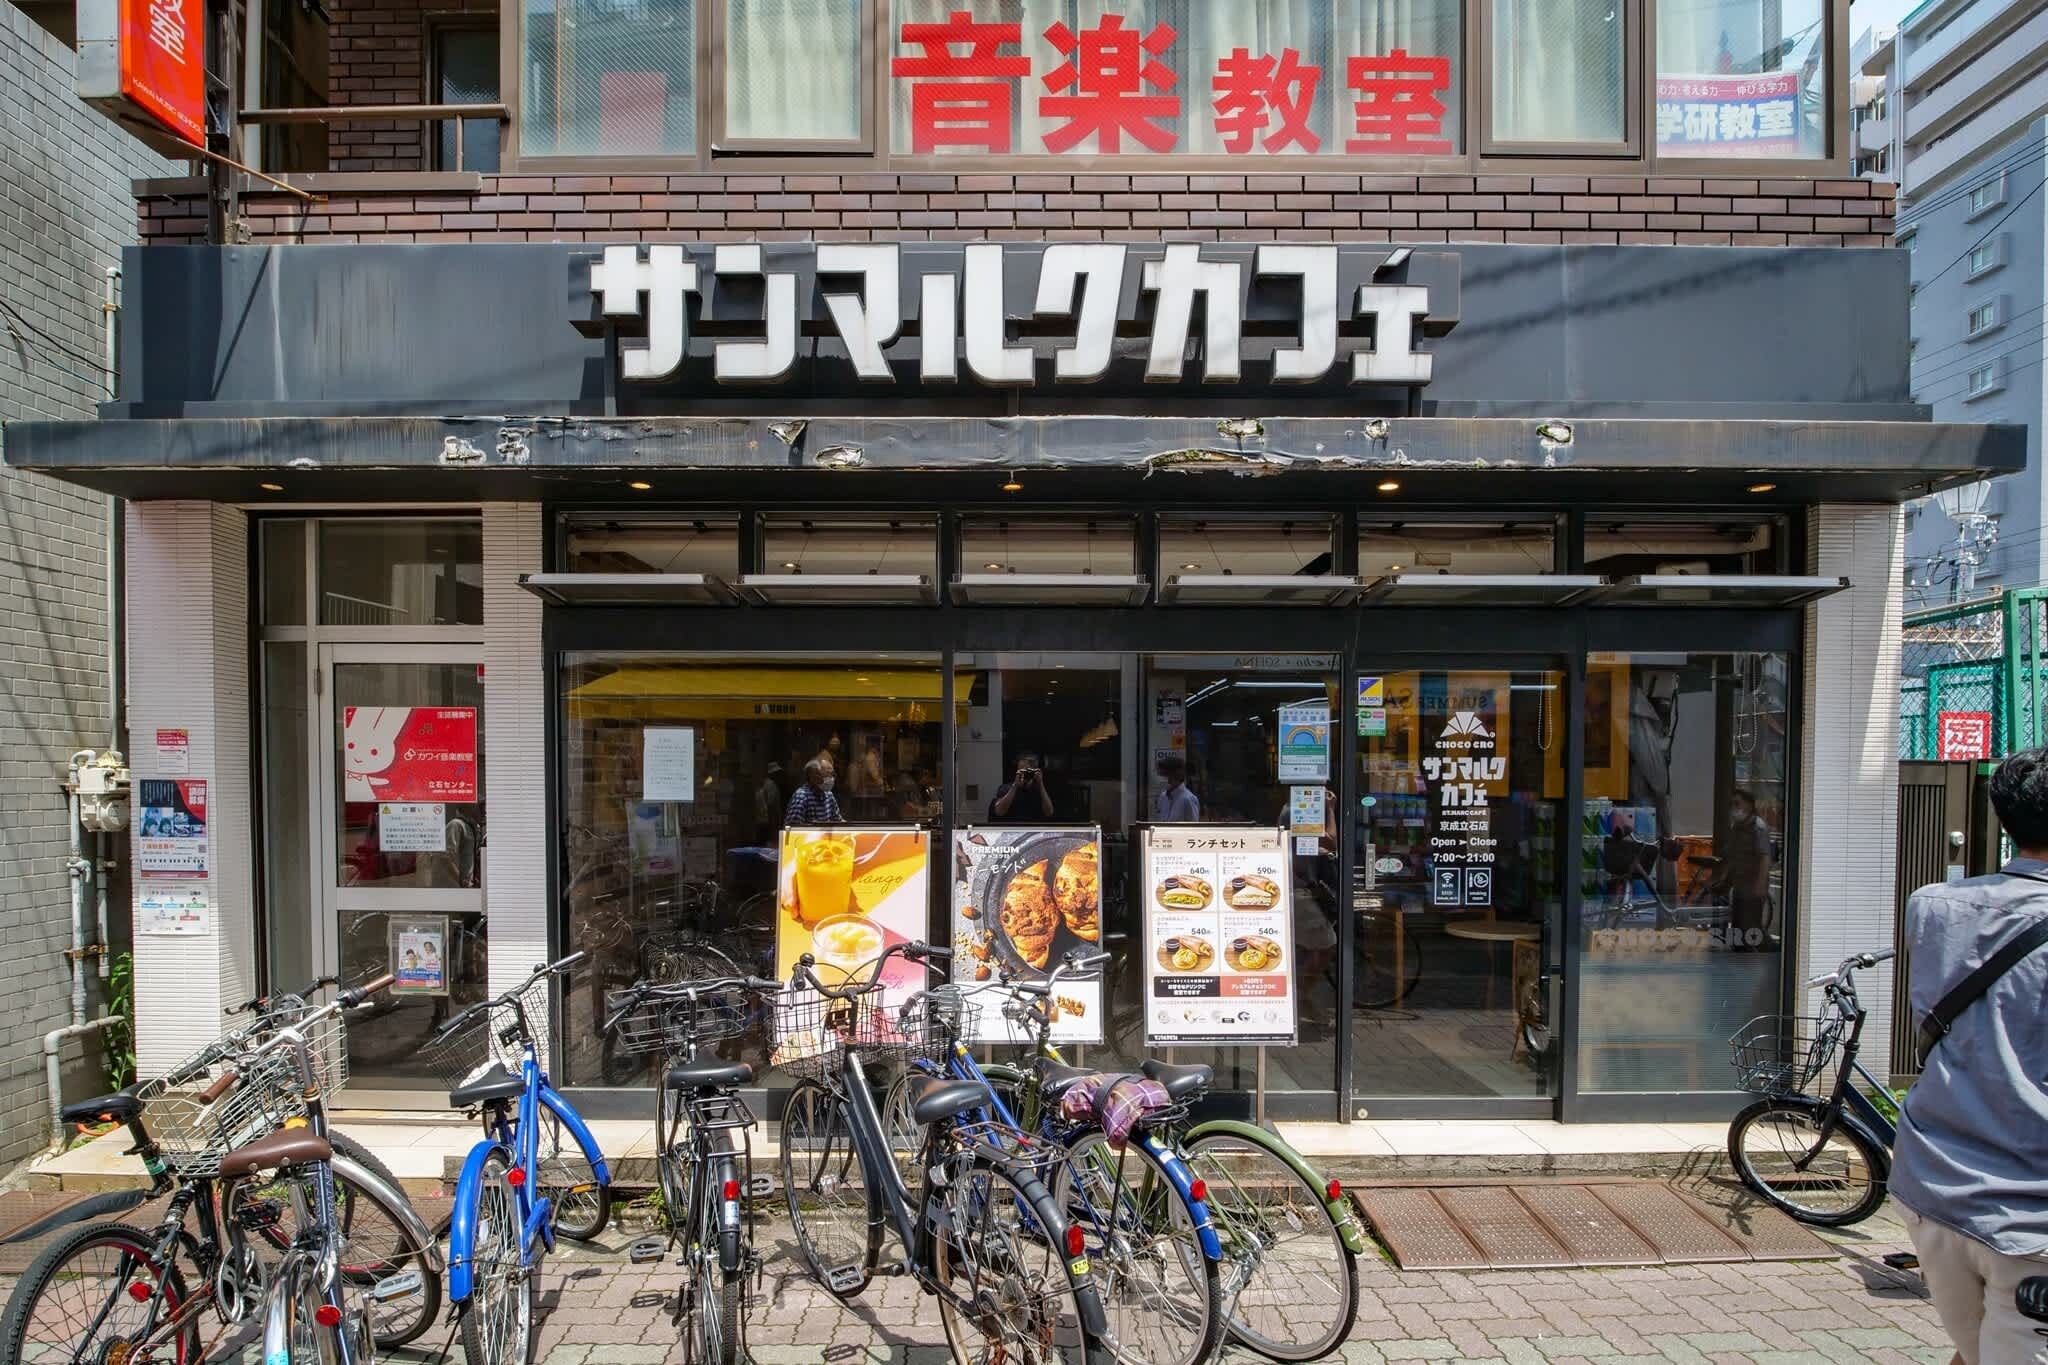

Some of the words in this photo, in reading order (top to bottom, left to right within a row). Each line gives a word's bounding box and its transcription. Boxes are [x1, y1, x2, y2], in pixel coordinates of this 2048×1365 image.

[893, 11, 1454, 155] 音楽教室
[589, 243, 1433, 384] サンマルクカフェ
[1435, 740, 1471, 749] CHOCO
[1473, 740, 1494, 749] CRO
[1422, 757, 1506, 781] サンマルク
[1440, 783, 1488, 806] カフェ
[1439, 821, 1489, 831] 京成立石店
[1187, 838, 1246, 849] ランチセット
[1431, 837, 1456, 848] Open
[1470, 837, 1497, 846] Close
[971, 846, 1020, 854] PREMIUM
